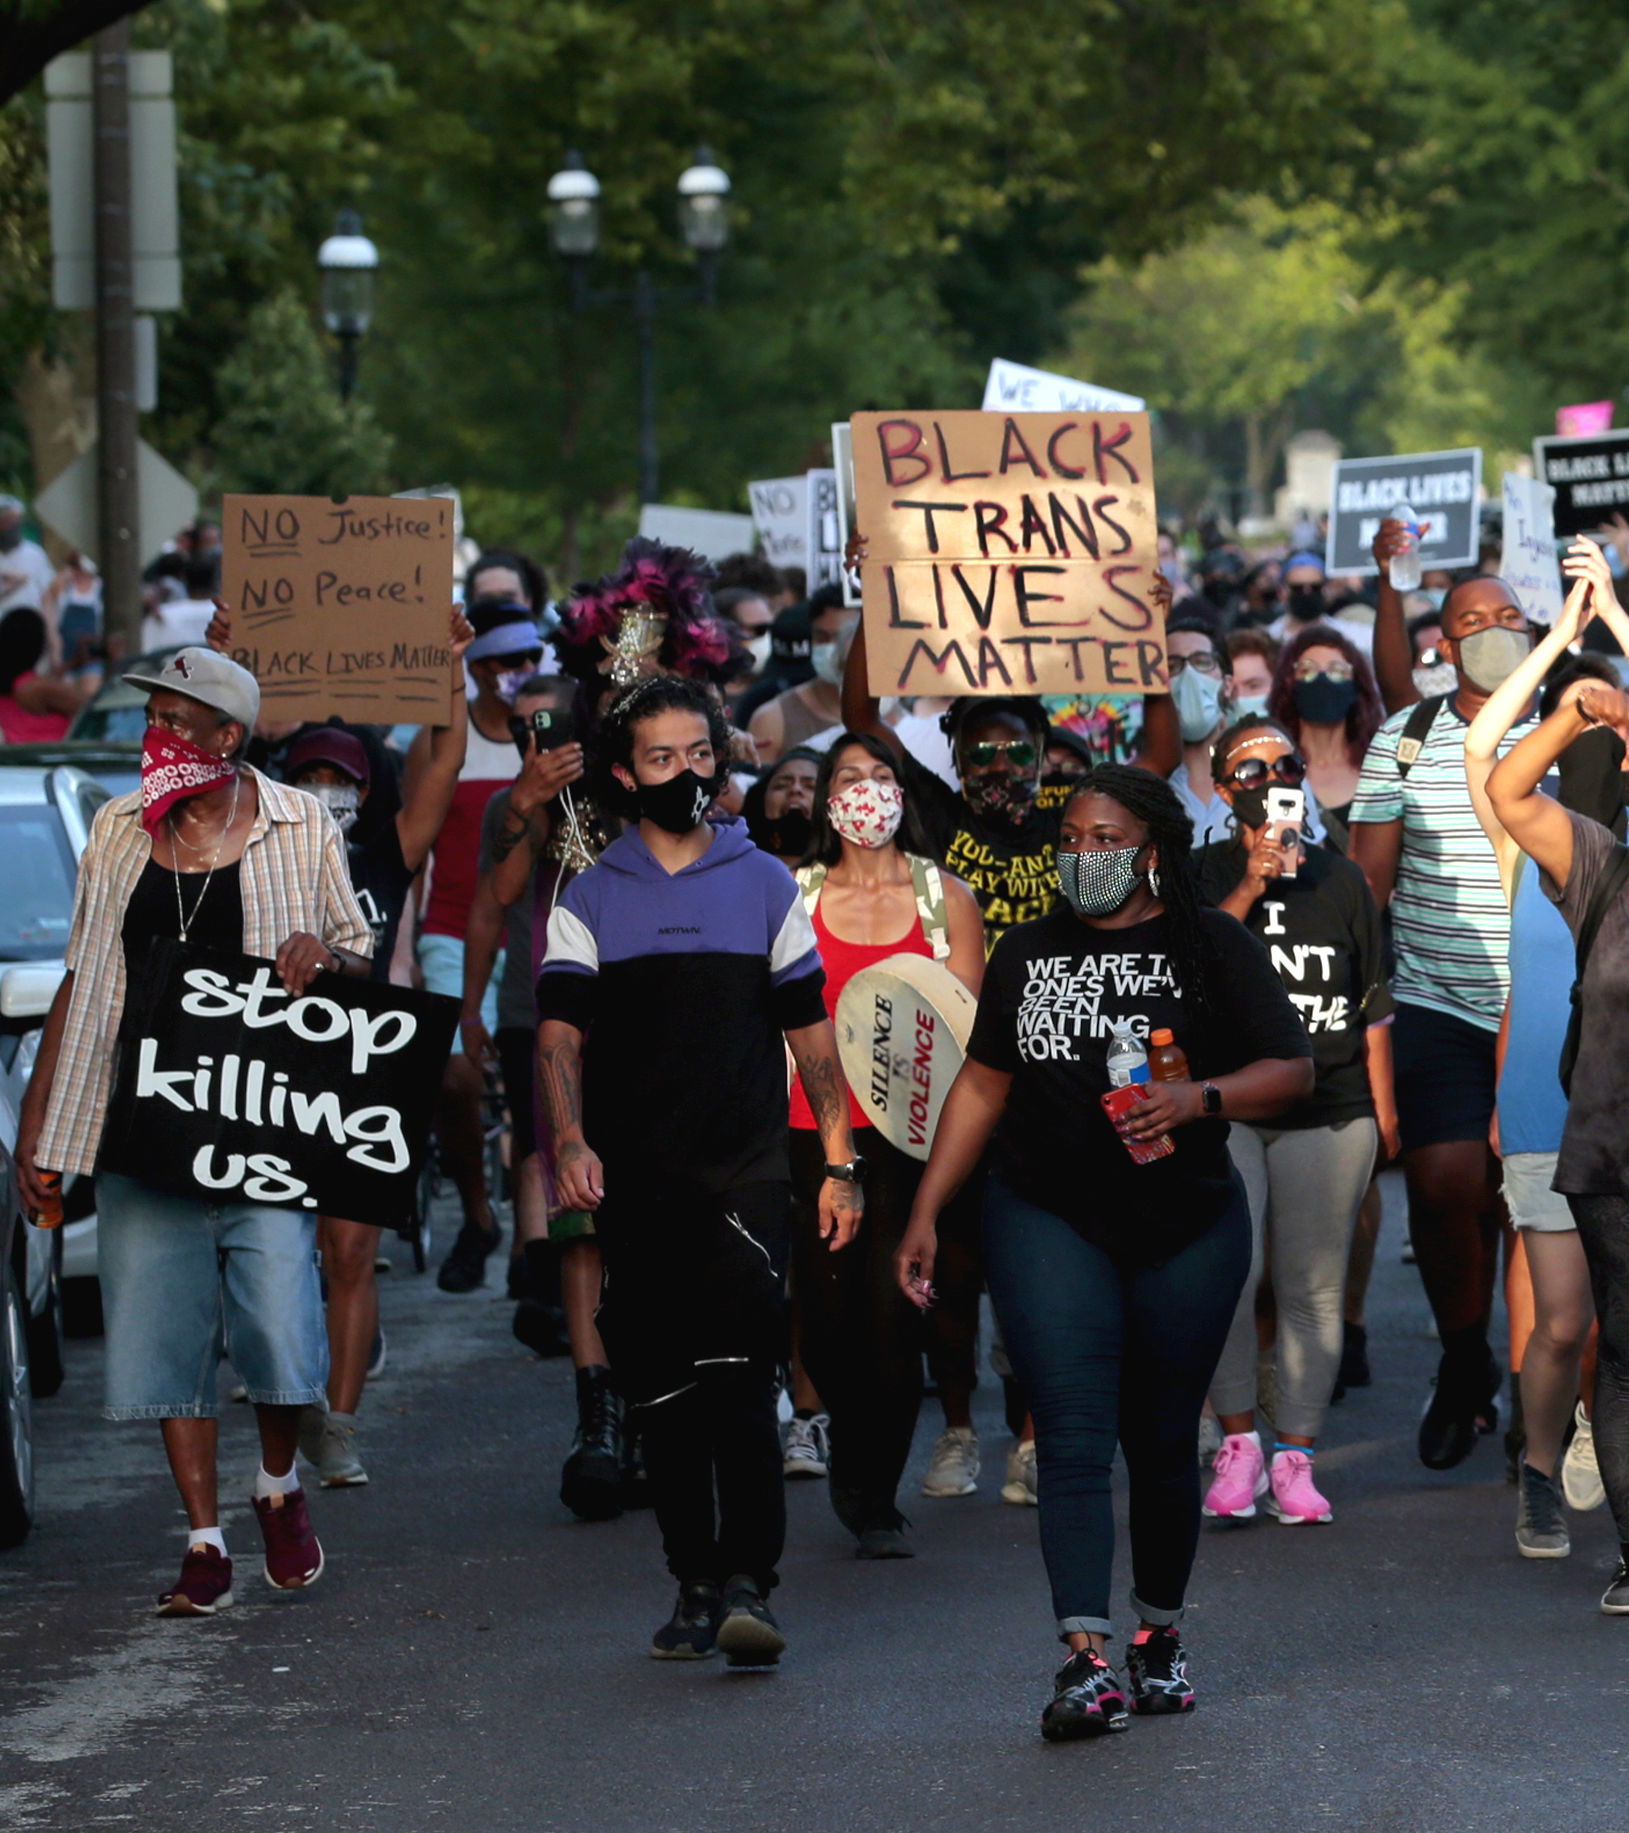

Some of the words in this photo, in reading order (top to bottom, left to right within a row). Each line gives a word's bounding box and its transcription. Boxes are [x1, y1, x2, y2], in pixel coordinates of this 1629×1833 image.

[999, 374, 1039, 407] WE
[877, 417, 1140, 487] BLACK
[1548, 453, 1605, 481] BLACK
[754, 485, 796, 517] NO
[1339, 478, 1405, 511] BLACK
[1410, 471, 1472, 502] LIVES
[241, 508, 300, 544] NO
[318, 508, 447, 545] Justice!
[892, 491, 1132, 561] TRANS
[241, 577, 295, 611] NO
[316, 564, 424, 607] Peace!
[883, 562, 1152, 632] LIVES
[231, 647, 321, 679] BLACK
[326, 651, 385, 675] LIVES
[389, 643, 450, 670] MATTER
[898, 635, 1169, 689] MATTER
[1006, 870, 1061, 897] WITH
[1263, 901, 1286, 935] I
[1026, 956, 1072, 979] WE
[1077, 954, 1141, 976] ARE
[1023, 976, 1105, 998] ONES
[181, 967, 417, 1074] stop
[1018, 996, 1100, 1016] BEEN
[1017, 1012, 1150, 1039] WAITING
[871, 994, 893, 1112] SILENCE
[1017, 1034, 1081, 1063] FOR.
[892, 1052, 912, 1083] IS
[908, 1009, 935, 1146] VIOLENCE
[136, 1037, 410, 1173] killing
[192, 1144, 318, 1208] us.
